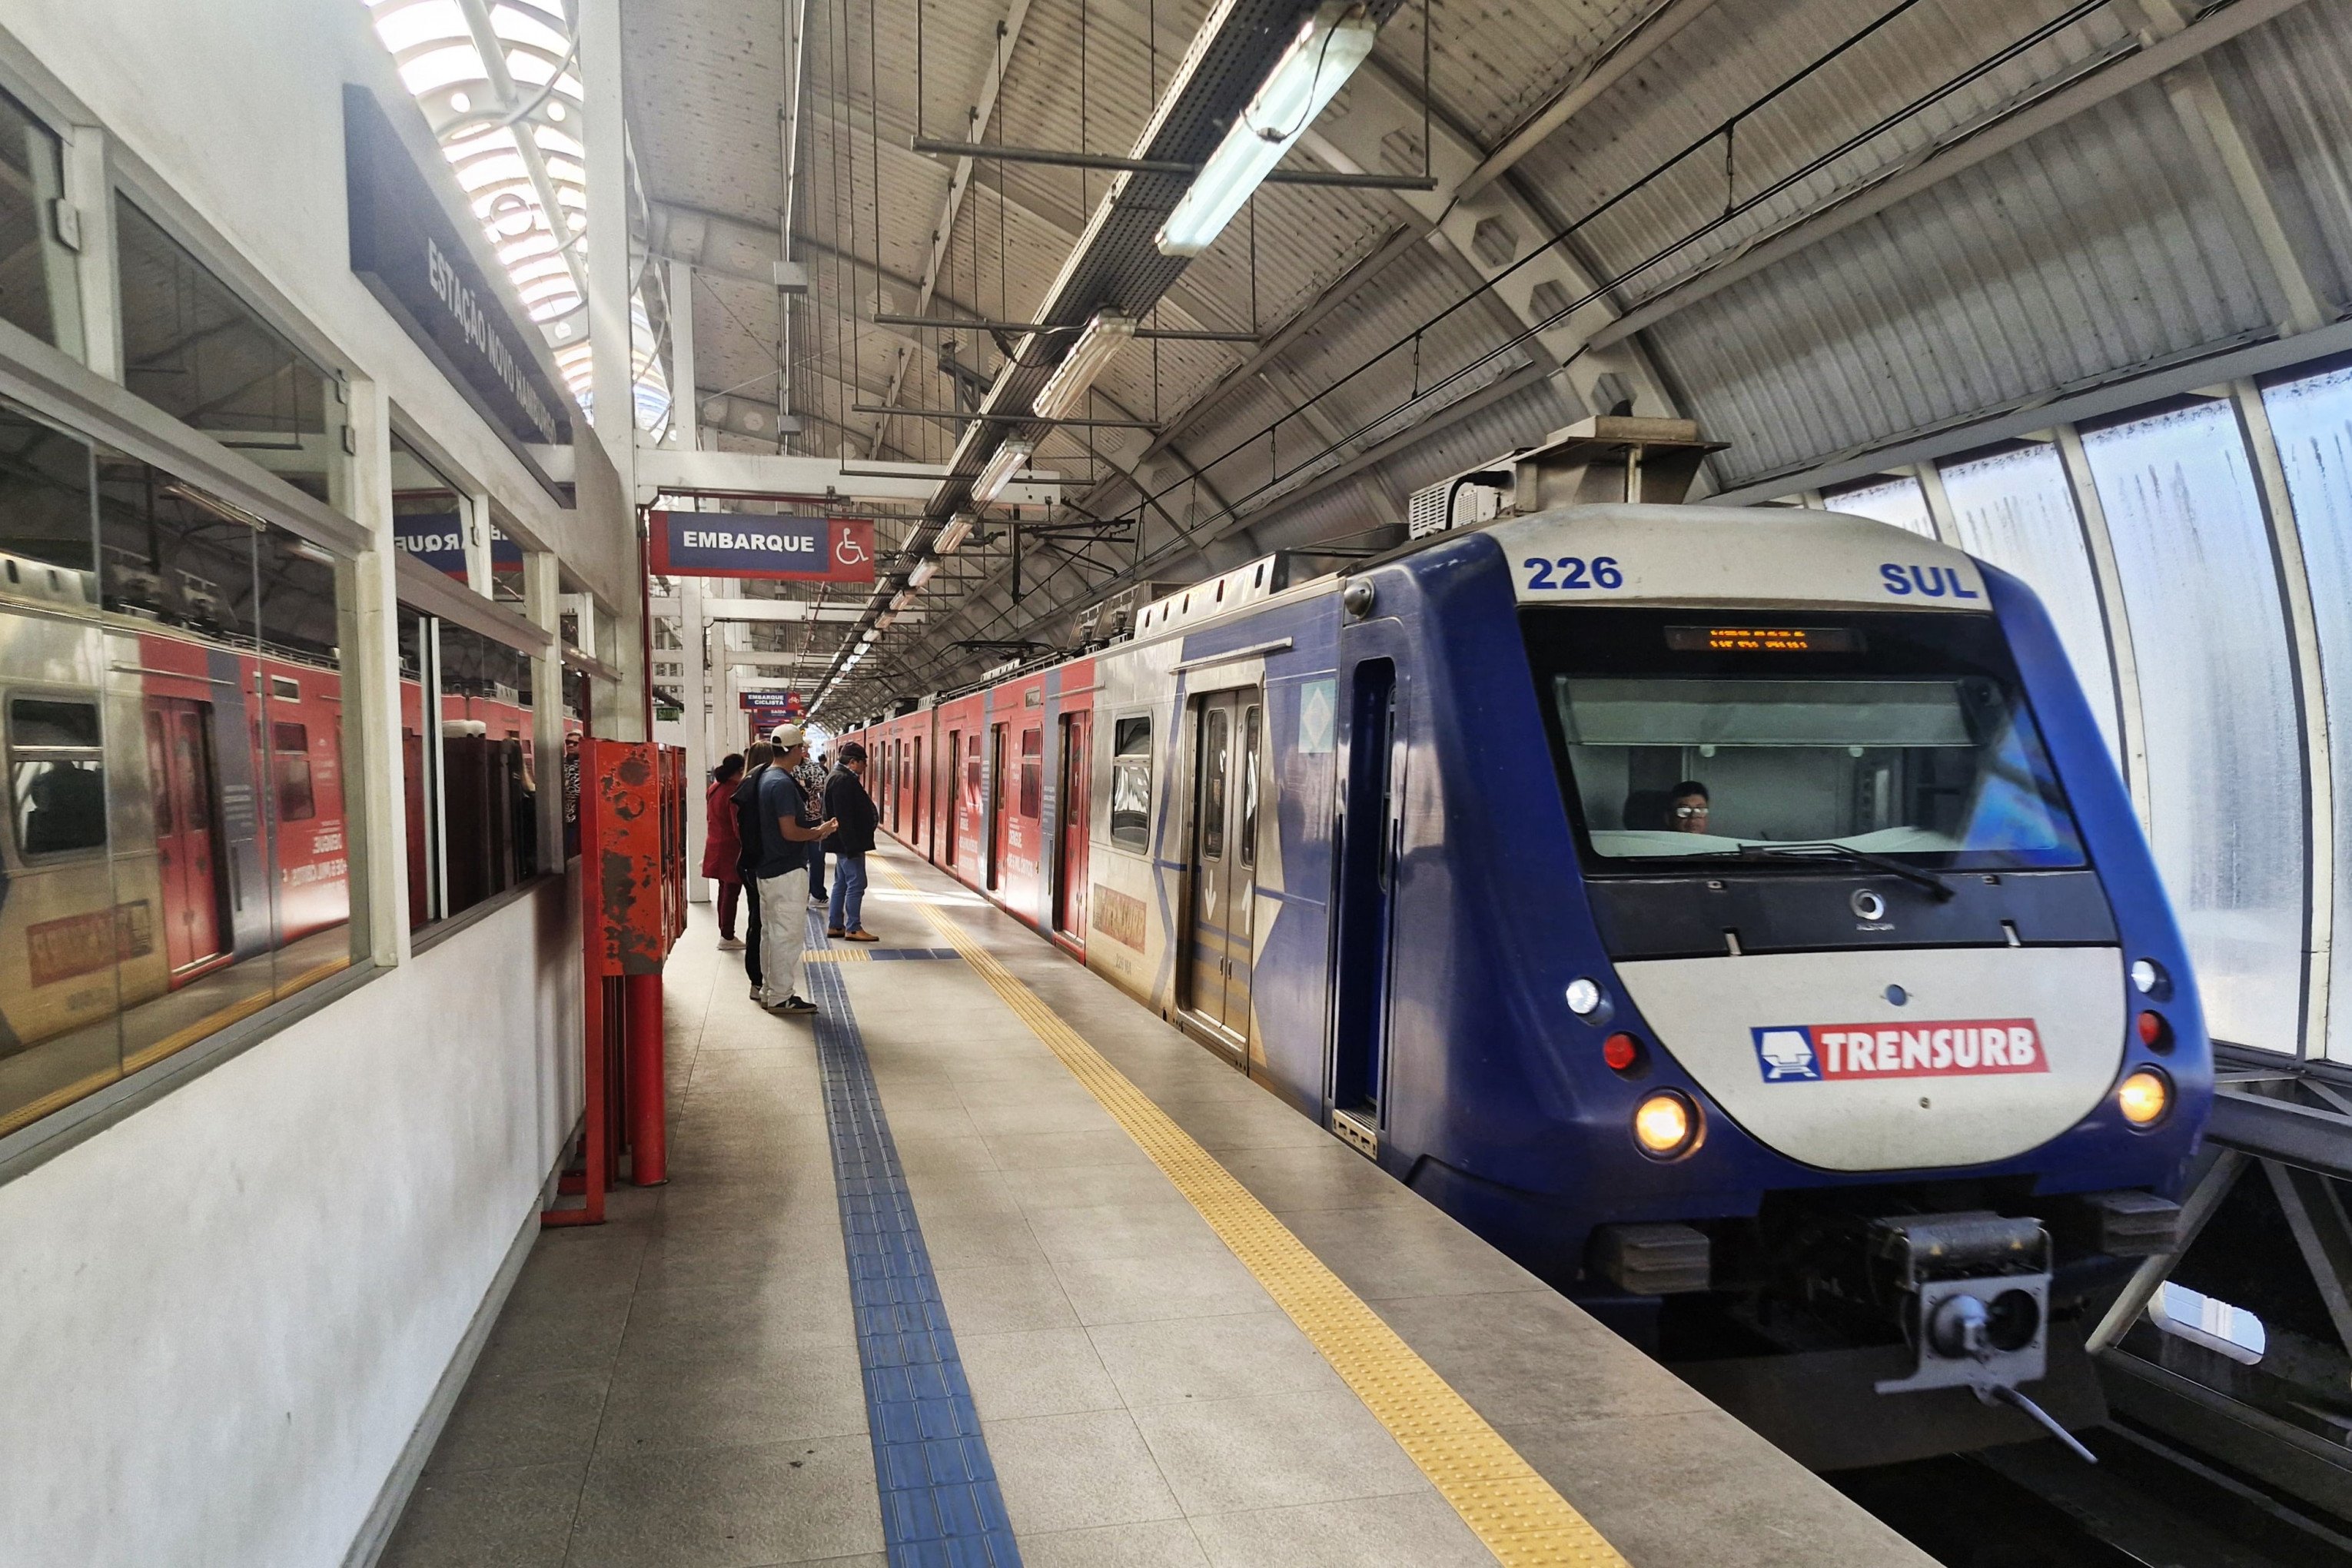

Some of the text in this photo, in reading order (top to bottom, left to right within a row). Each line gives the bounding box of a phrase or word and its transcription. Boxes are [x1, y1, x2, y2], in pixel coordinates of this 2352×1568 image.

[428, 236, 486, 354] ESTAÇÃO
[488, 321, 514, 394] NOVO
[683, 530, 815, 553] EMBARQUE
[1523, 556, 1623, 590] 226
[1879, 563, 1979, 599] SUL
[1821, 1027, 2037, 1073] TRENSURB
